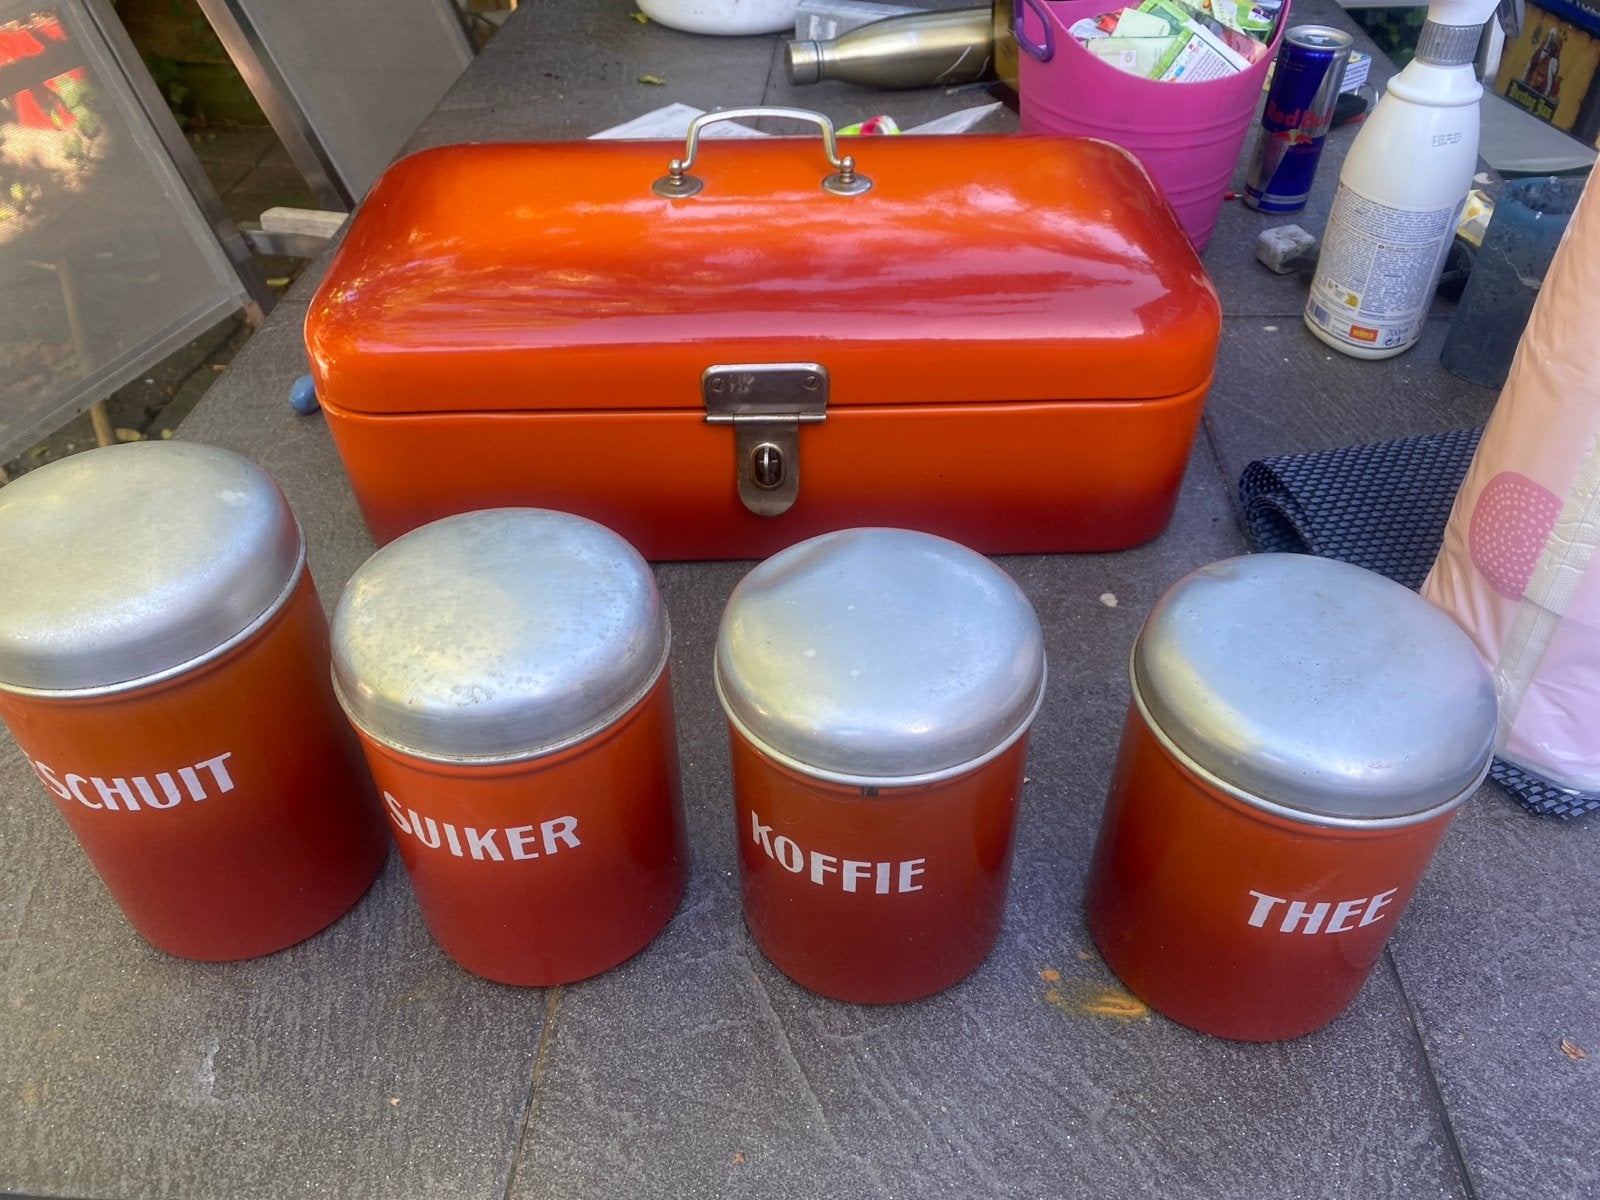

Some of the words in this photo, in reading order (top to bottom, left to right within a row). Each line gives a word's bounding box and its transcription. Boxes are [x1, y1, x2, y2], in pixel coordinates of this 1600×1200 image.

[1266, 103, 1300, 127] Red
[20, 746, 234, 811] SCHUIT
[384, 791, 580, 861] SUIKER
[752, 811, 926, 893] KOFFIE
[1248, 887, 1398, 935] THEE
